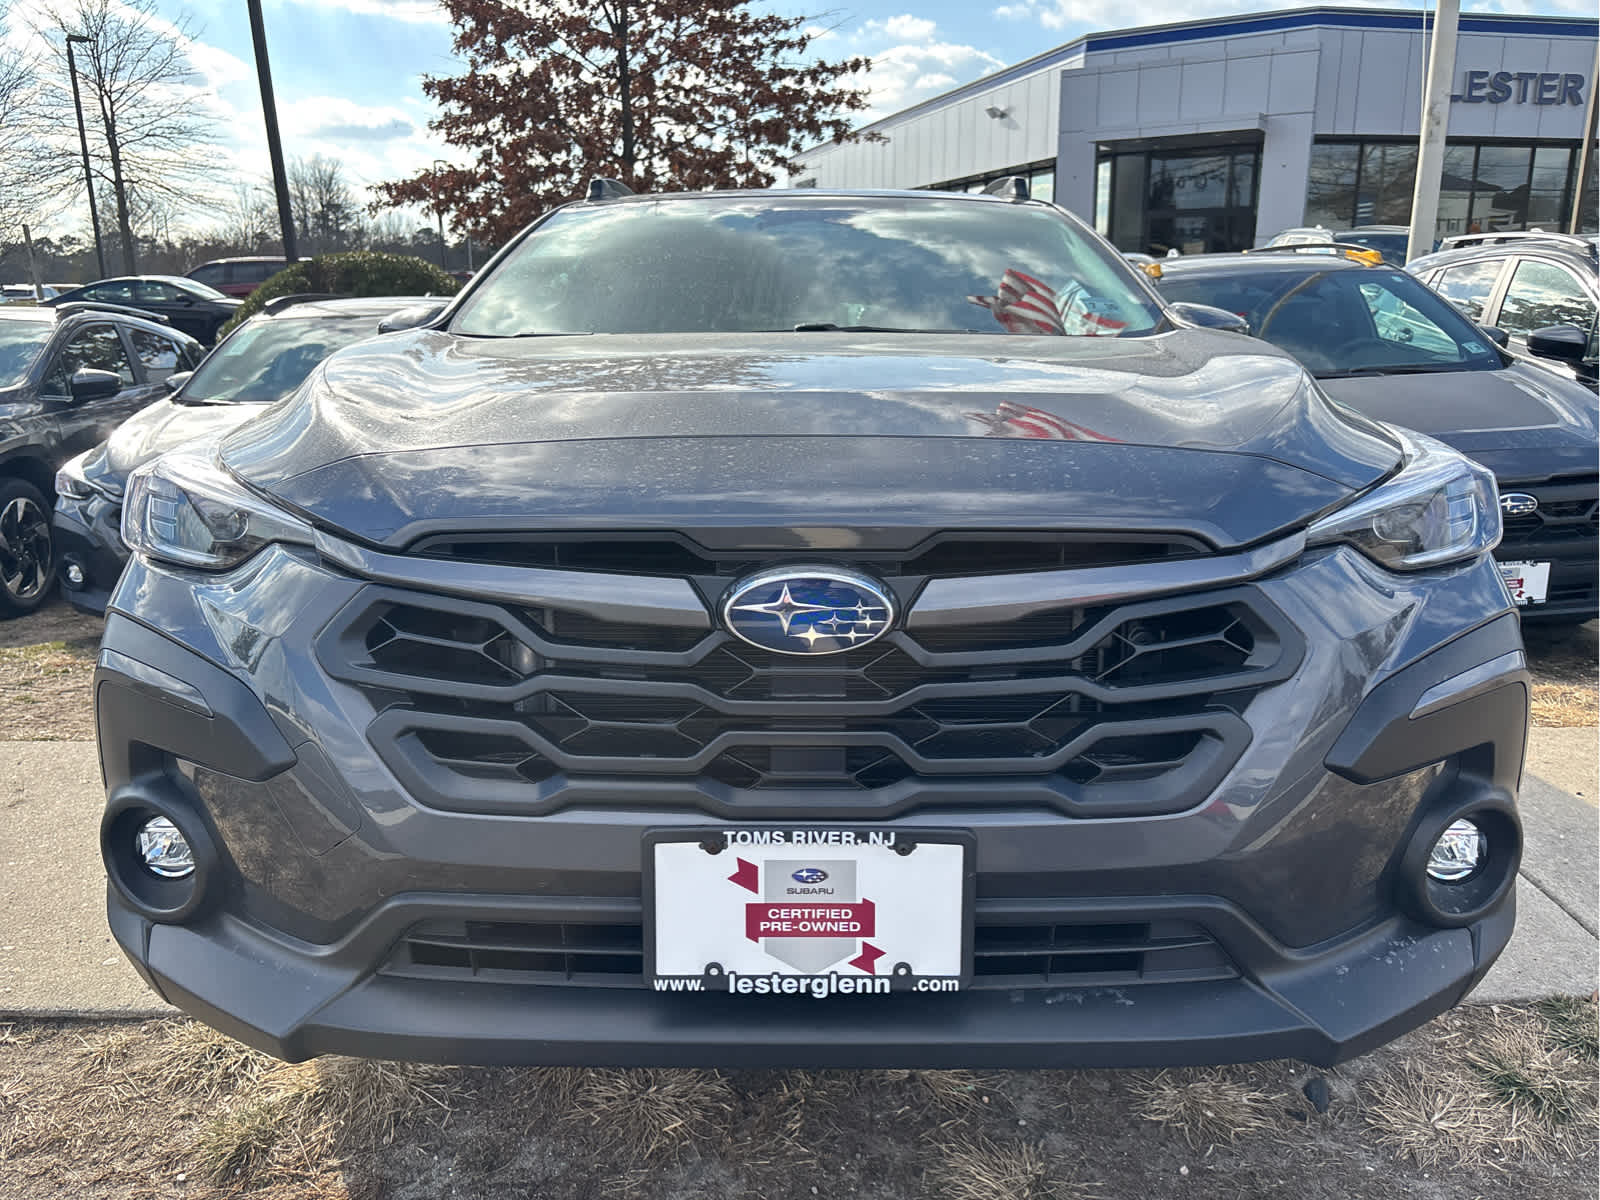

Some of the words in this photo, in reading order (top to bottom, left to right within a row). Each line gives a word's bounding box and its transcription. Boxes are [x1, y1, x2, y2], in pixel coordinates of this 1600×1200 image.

[723, 831, 785, 845] TOMS
[792, 831, 861, 846] RIVER,
[868, 831, 896, 846] NJ
[786, 887, 835, 895] SUBARU
[767, 908, 853, 919] CERTIFIED
[759, 921, 861, 932] PRE-OWNED
[653, 979, 705, 991] www.
[728, 973, 891, 999] lesterglenn
[912, 978, 960, 992] .com
